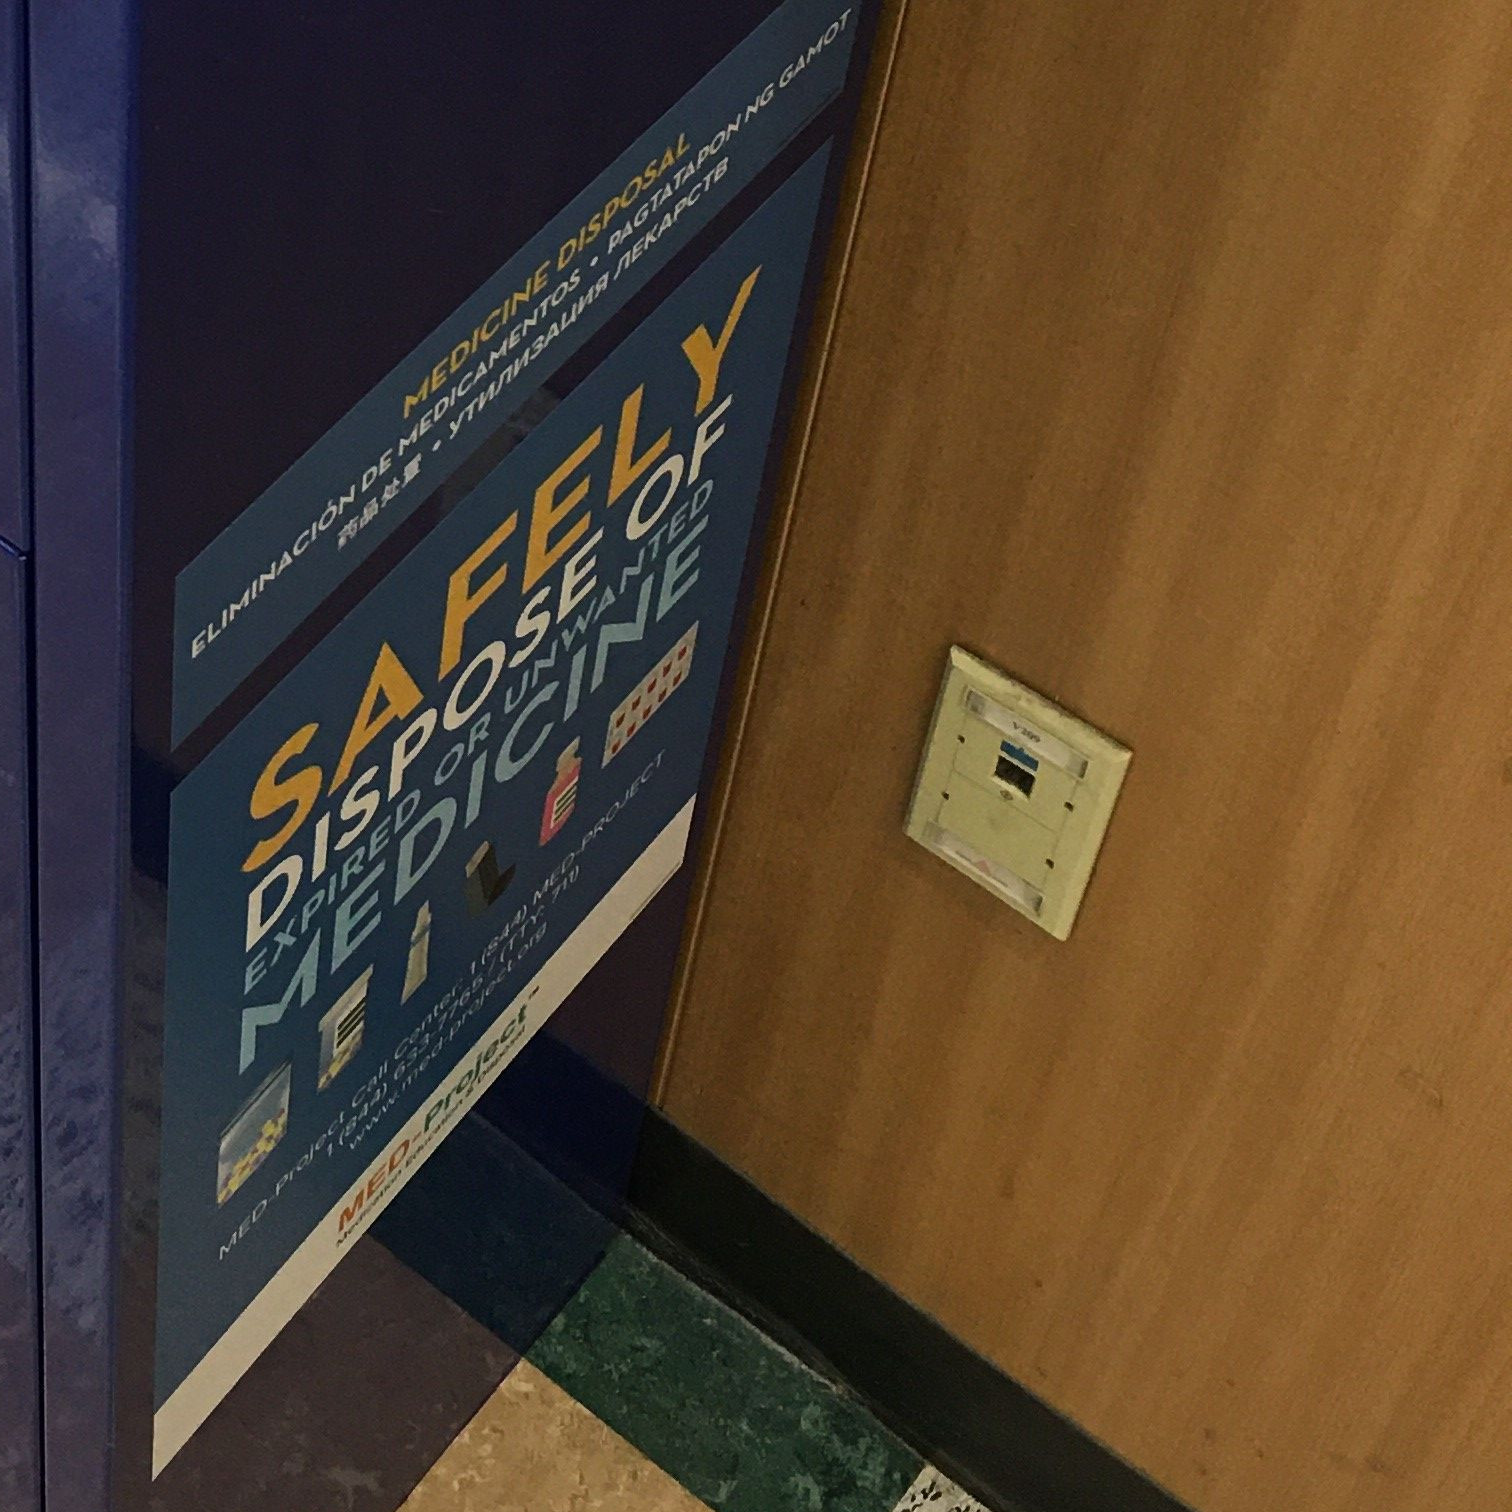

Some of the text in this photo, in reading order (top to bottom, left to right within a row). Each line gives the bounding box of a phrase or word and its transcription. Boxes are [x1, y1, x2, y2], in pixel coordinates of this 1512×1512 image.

[191, 8, 851, 658] ELIMINACIÓN DE MEDICAMENTOS PAGTATAPON NG GAMOT
[403, 133, 690, 418] MEDICINE DISPOSAL
[449, 272, 609, 438] УТИЛИЗАЦИЯ
[613, 157, 729, 279] ЛЕКАРСТВ
[239, 515, 709, 1074] MEDICINE
[242, 266, 761, 872] SAFELY
[244, 479, 713, 993] EXPIRED OR UNWANTED
[245, 393, 733, 952] DISPOSE OF
[349, 921, 547, 1149] www.med-project.org
[351, 1059, 388, 1108] Call
[394, 978, 463, 1060] Center:
[470, 960, 476, 975] 1
[481, 903, 528, 965] (844)
[532, 749, 664, 905] MED-PROJECT
